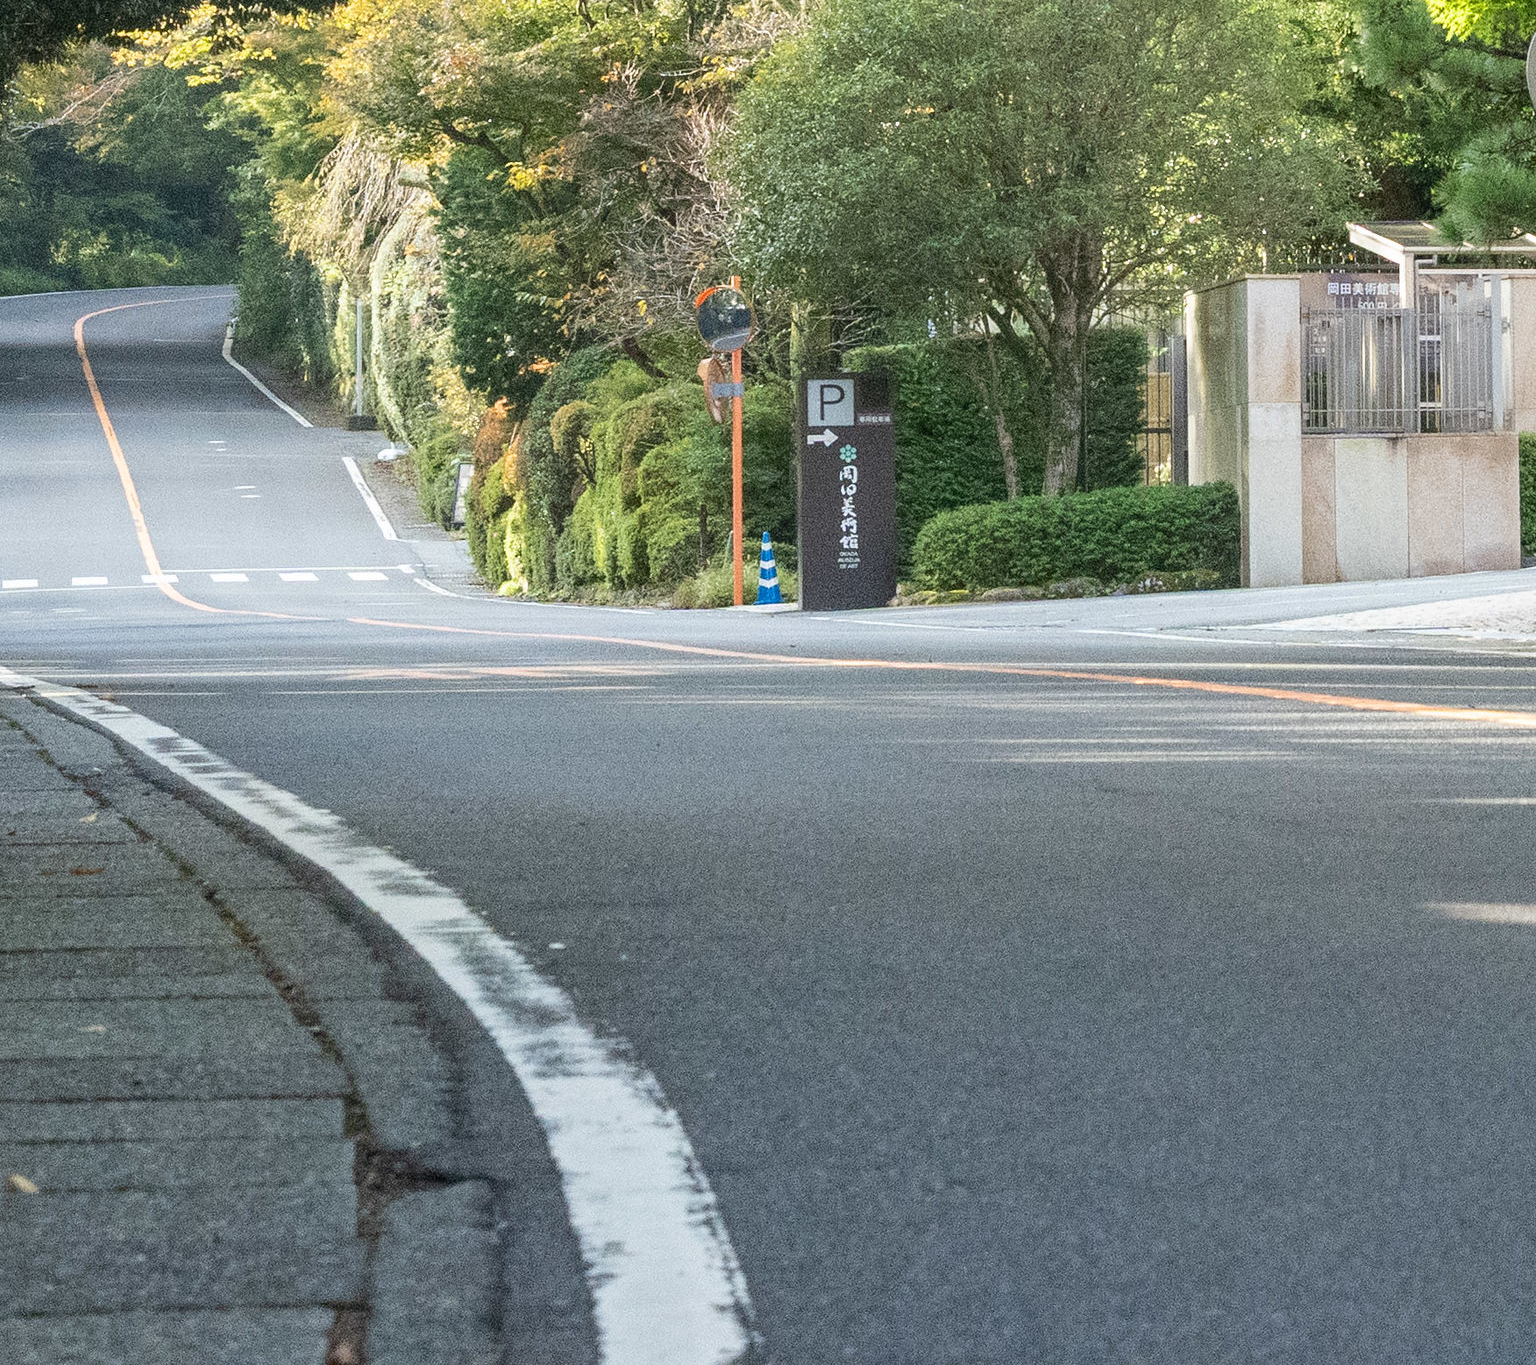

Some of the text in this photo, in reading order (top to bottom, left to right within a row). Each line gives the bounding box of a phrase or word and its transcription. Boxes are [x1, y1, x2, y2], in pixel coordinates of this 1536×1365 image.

[820, 384, 845, 421] P
[839, 465, 859, 550] 岡田美術館
